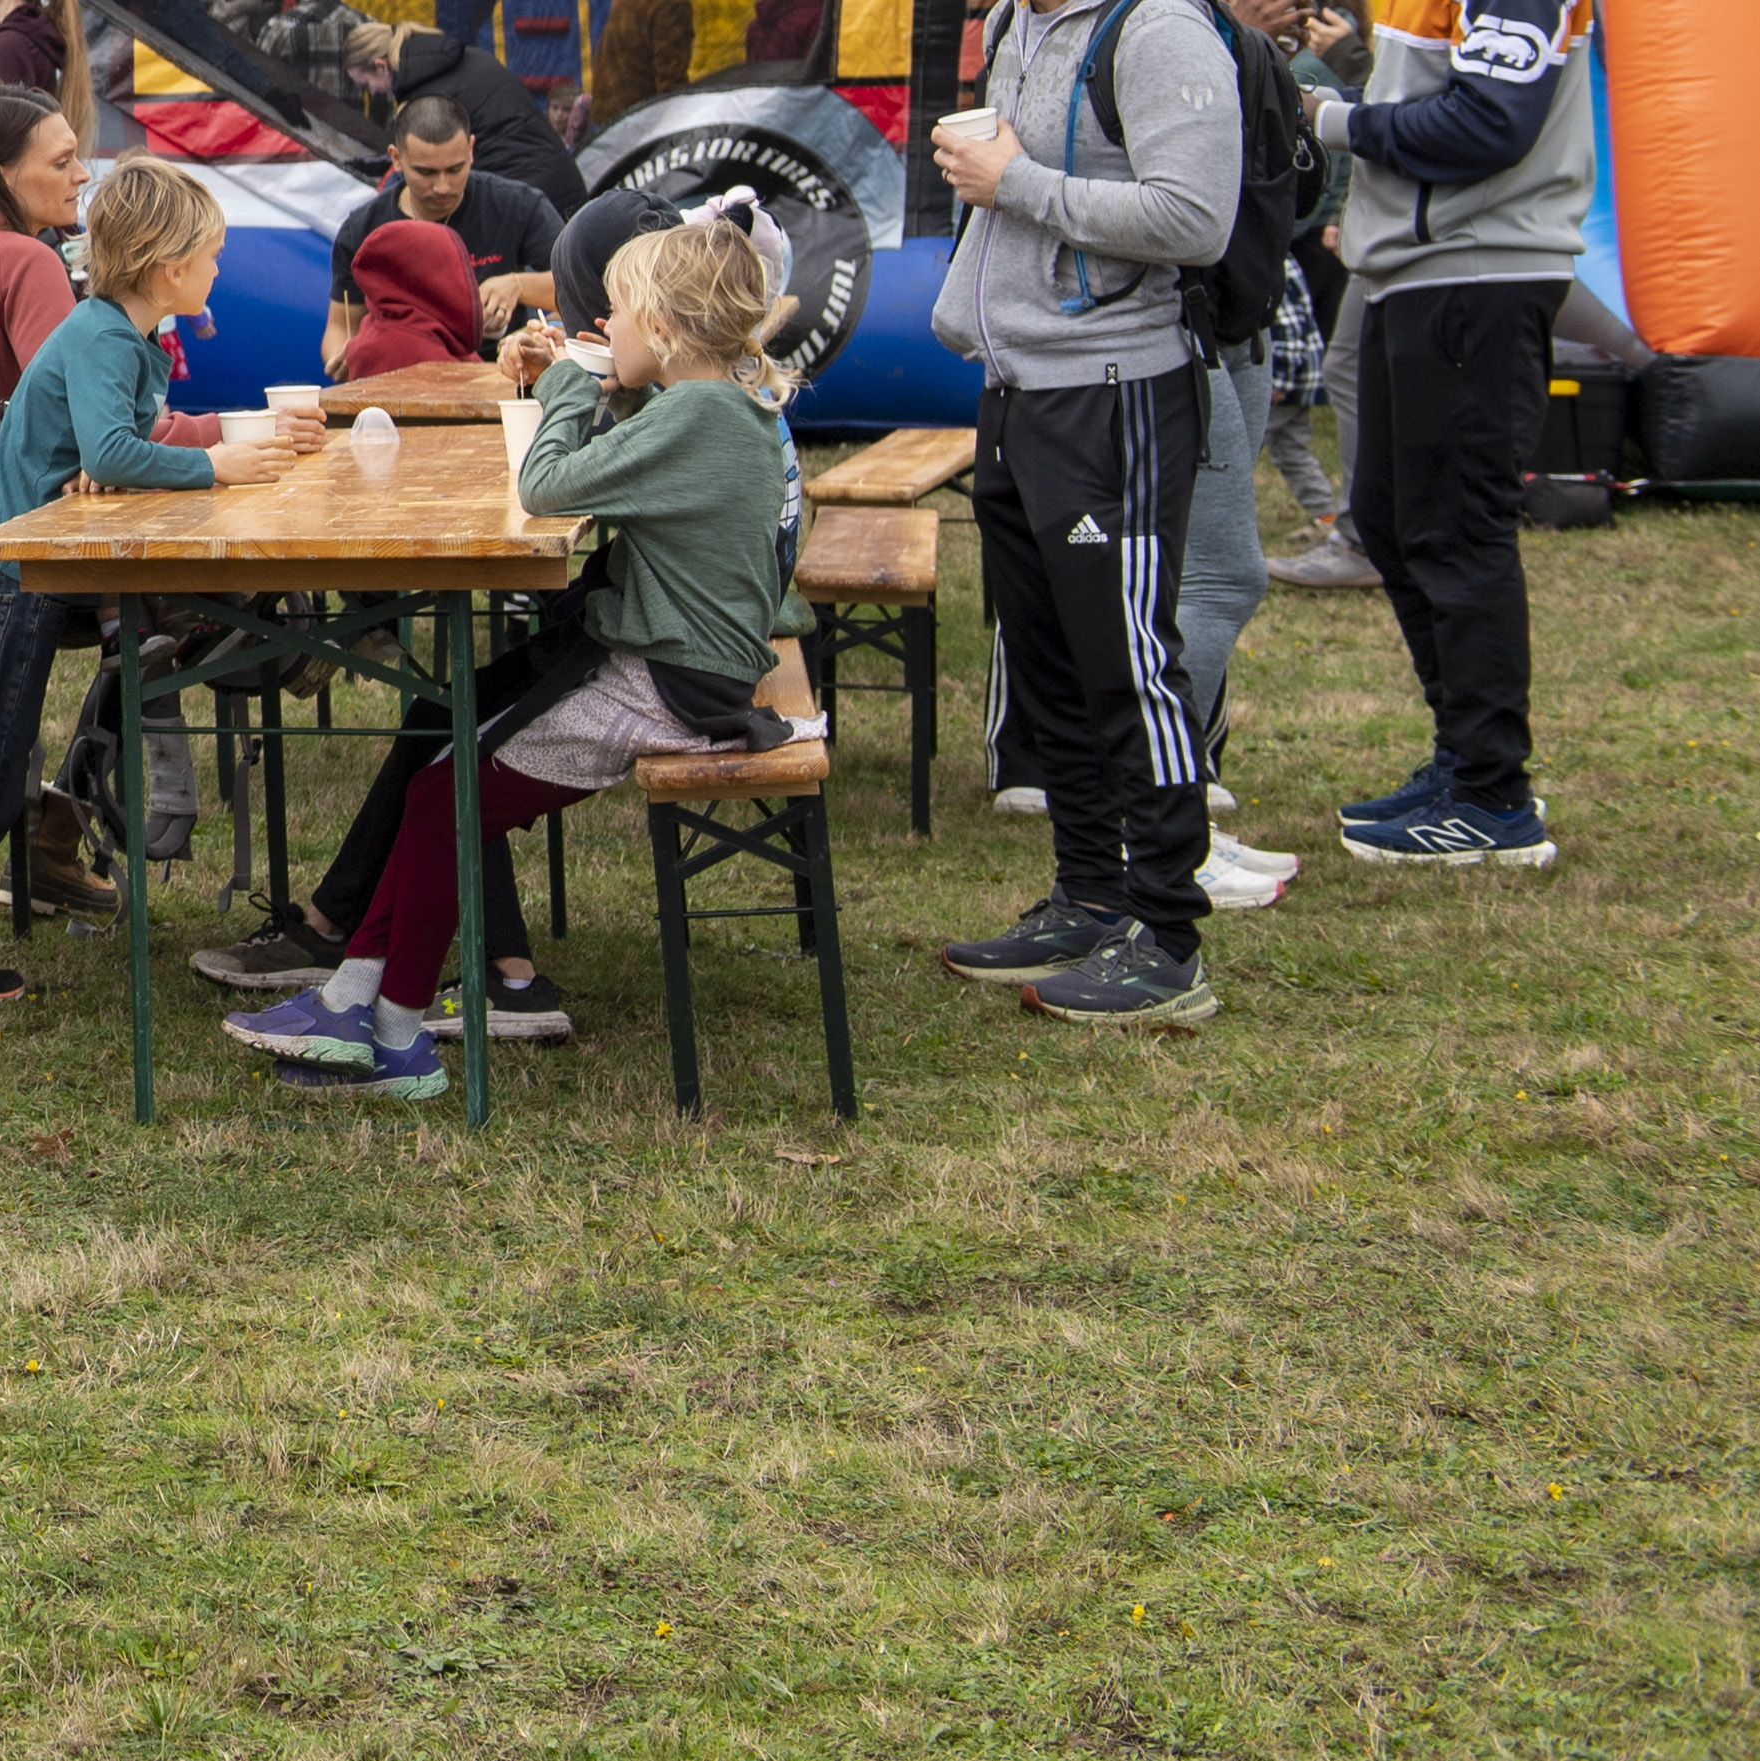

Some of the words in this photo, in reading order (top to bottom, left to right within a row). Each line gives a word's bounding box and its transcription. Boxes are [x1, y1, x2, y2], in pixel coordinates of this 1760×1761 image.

[616, 143, 690, 191] IRES
[693, 137, 759, 163] FOR
[756, 146, 837, 212] FIRES
[822, 258, 856, 335] TUFF
[1068, 533, 1109, 544] adidas
